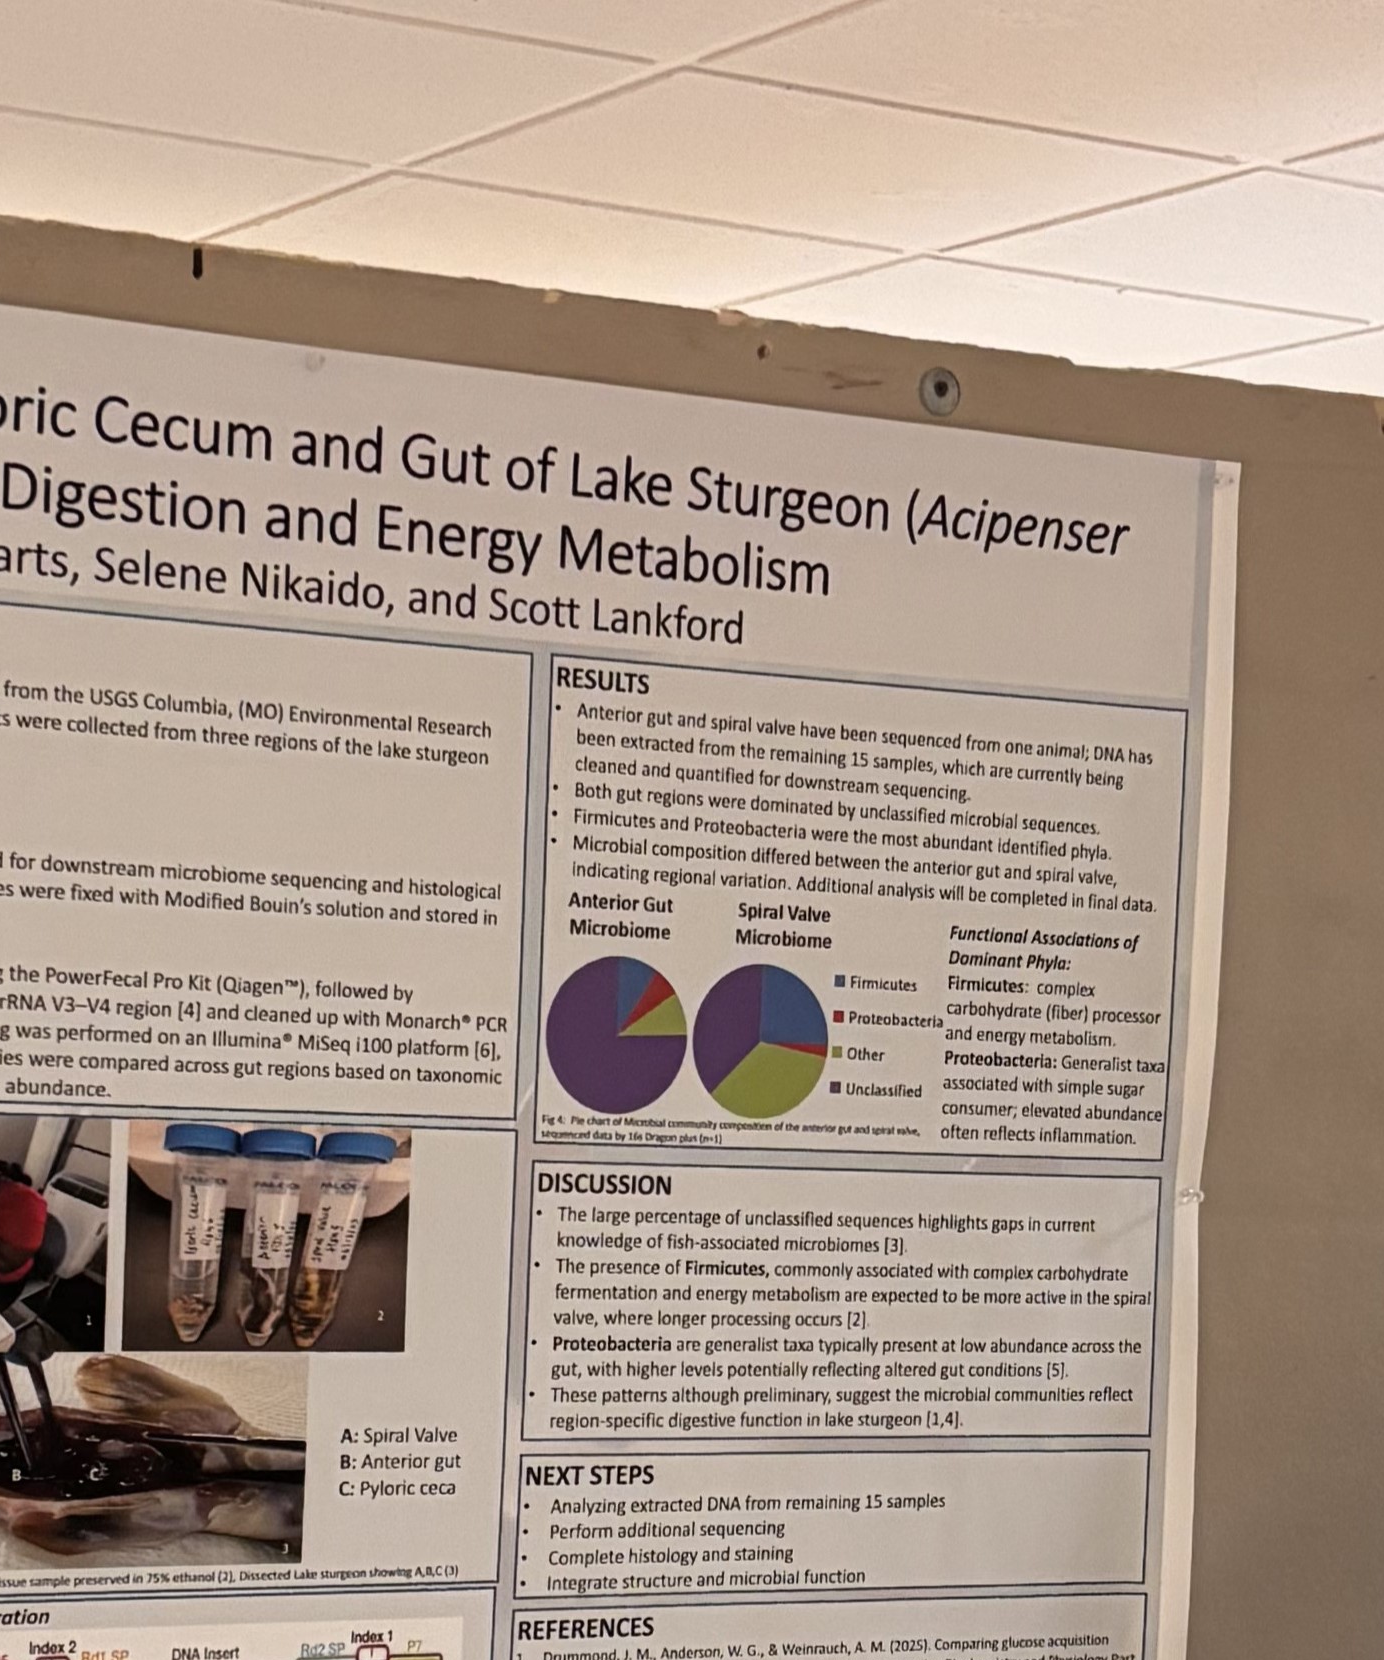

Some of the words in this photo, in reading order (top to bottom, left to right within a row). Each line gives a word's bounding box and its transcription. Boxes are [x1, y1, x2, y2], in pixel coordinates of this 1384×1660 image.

[94, 395, 272, 462] Cecum
[291, 425, 383, 475] and
[401, 432, 491, 487] Gut
[506, 445, 558, 494] of
[571, 451, 673, 507] Lake
[687, 466, 889, 533] Sturgeon
[906, 487, 1131, 556] (Acipenser
[2, 461, 246, 535] Digestion
[265, 497, 358, 547] and
[377, 504, 543, 577] Energy
[559, 524, 830, 597] Metabolism
[93, 546, 227, 594] Selene
[242, 561, 394, 618] Nikaido,
[408, 583, 477, 620] and
[489, 587, 581, 630] Scott
[593, 597, 744, 645] Lankford
[556, 666, 650, 695] RESULTS
[567, 891, 640, 912] Anterior
[643, 896, 674, 914] Gut
[738, 902, 784, 922] Spiral
[787, 904, 832, 923] Valve
[569, 918, 671, 941] Microbiome
[735, 928, 833, 950] Microbiome
[949, 925, 1029, 944] Functional
[1030, 929, 1120, 950] Associations
[1123, 934, 1141, 954] of
[948, 949, 1024, 969] Dominant
[1026, 953, 1072, 974] Phyla:
[850, 975, 918, 993] Firmicutes
[848, 1010, 944, 1029] Proteobacteria
[846, 1046, 886, 1062] Other
[845, 1082, 923, 1098] Unclassified
[536, 1171, 673, 1197] DISCUSSION
[340, 1428, 359, 1444] A:
[363, 1426, 410, 1448] Spiral
[414, 1426, 458, 1443] Valve
[339, 1454, 357, 1470] B:
[360, 1453, 431, 1470] Anterior
[434, 1454, 462, 1473] gut
[524, 1464, 587, 1487] NEXT
[589, 1464, 655, 1486] STEPS
[338, 1480, 355, 1497] C:
[360, 1479, 416, 1500] Pyloric
[419, 1482, 456, 1496] ceca
[350, 1629, 384, 1644] Index
[387, 1629, 393, 1642] 1
[517, 1616, 656, 1642] REFERENCES
[28, 1640, 65, 1655] Index
[68, 1639, 77, 1654] 2
[203, 1646, 240, 1660] Insert
[408, 1640, 422, 1652] P7
